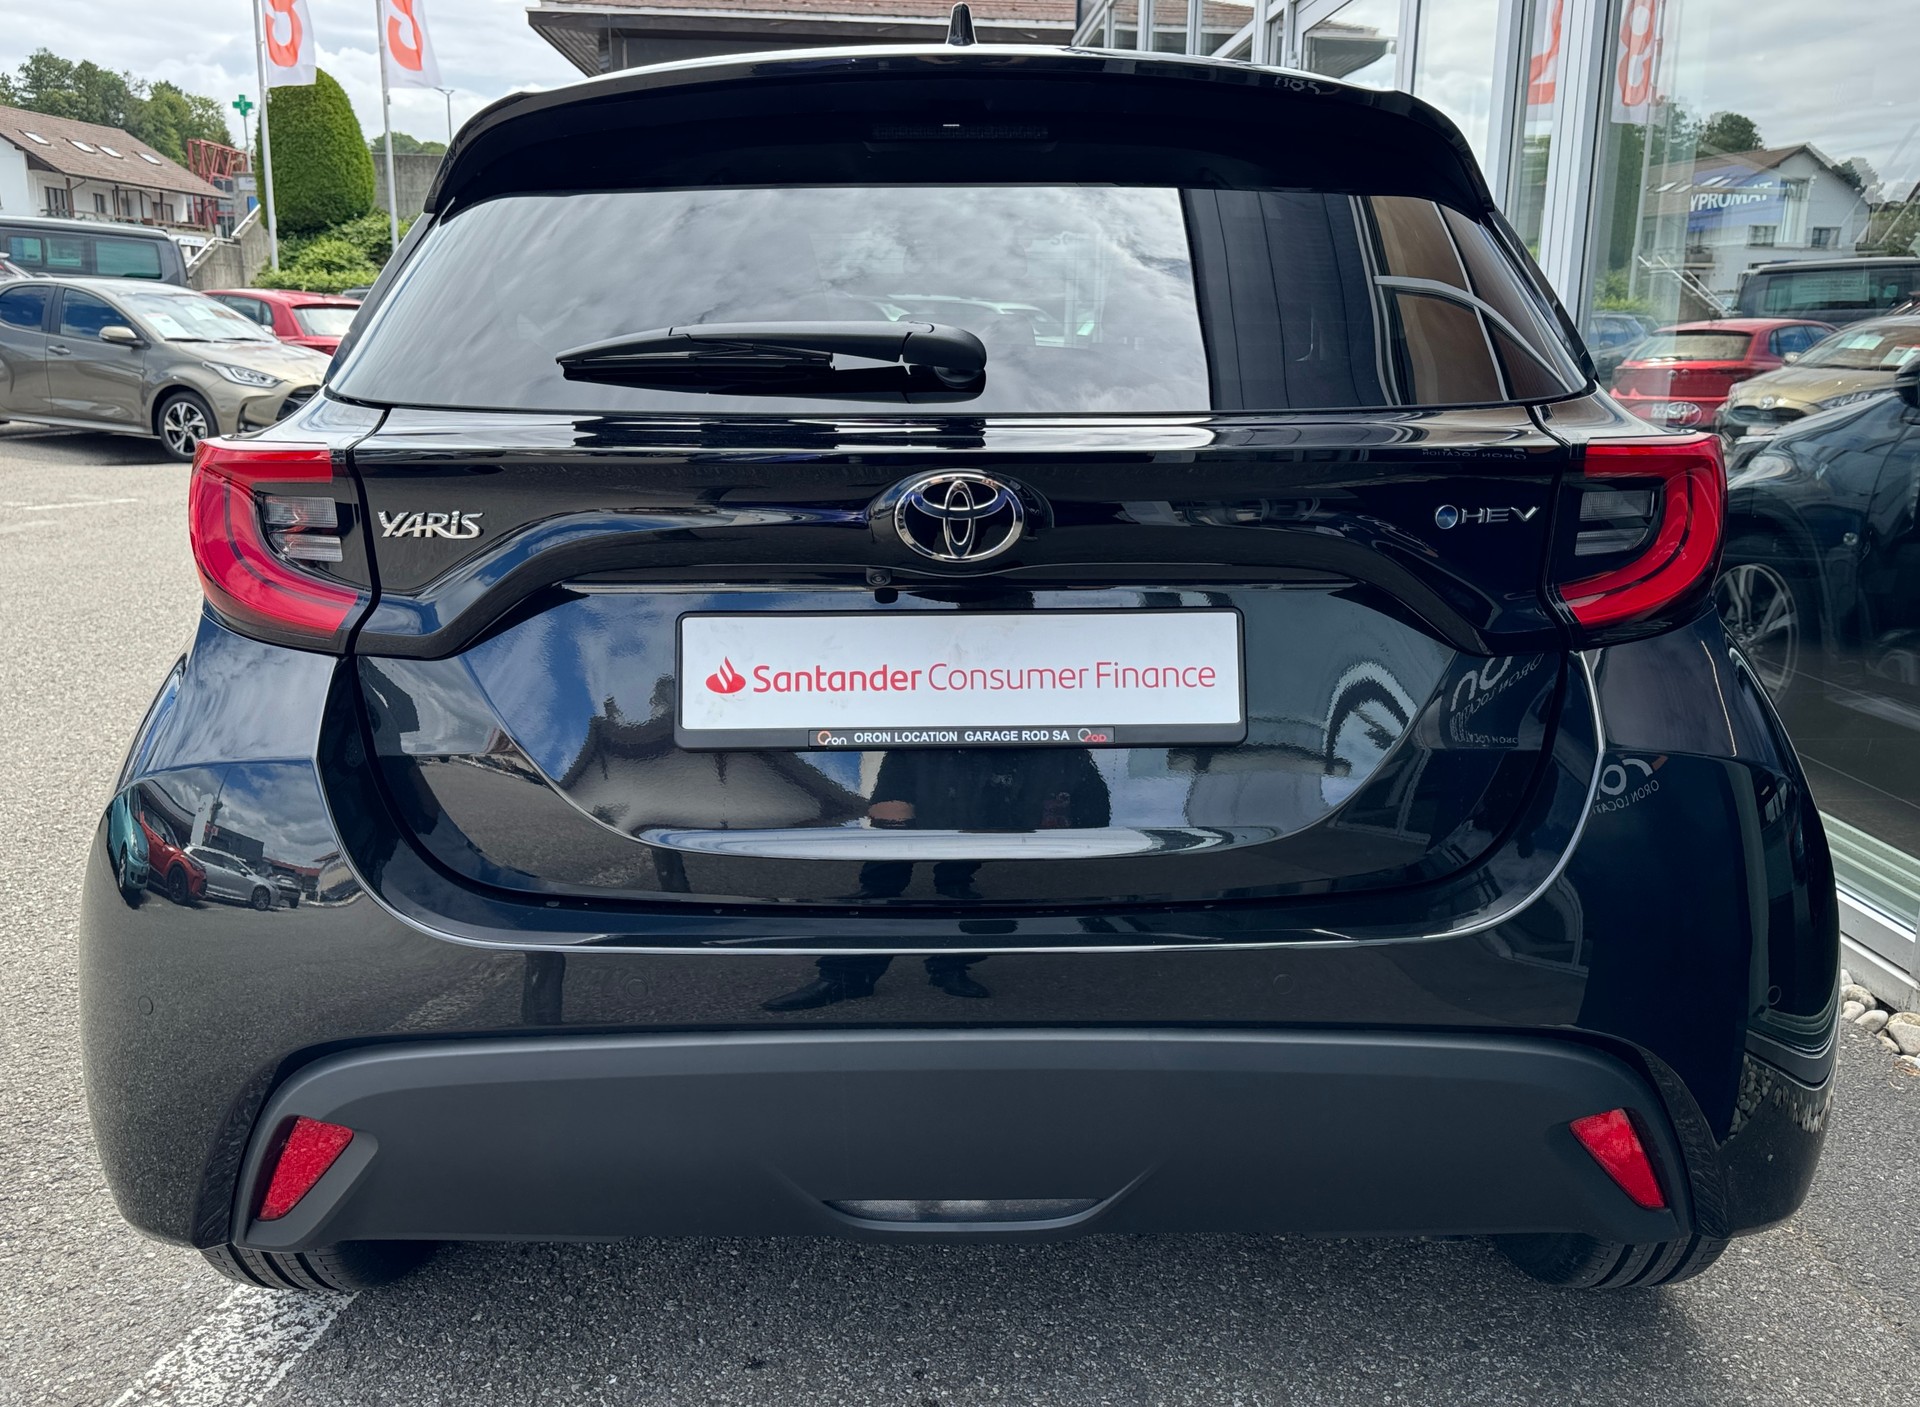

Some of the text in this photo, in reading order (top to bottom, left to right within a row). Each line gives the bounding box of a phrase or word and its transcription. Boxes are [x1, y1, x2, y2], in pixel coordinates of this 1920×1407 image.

[1461, 506, 1540, 524] HEV
[753, 661, 1216, 693] Santander Consumer Finance
[853, 730, 1070, 743] ORON LOCATION GARAGE ROD SA
